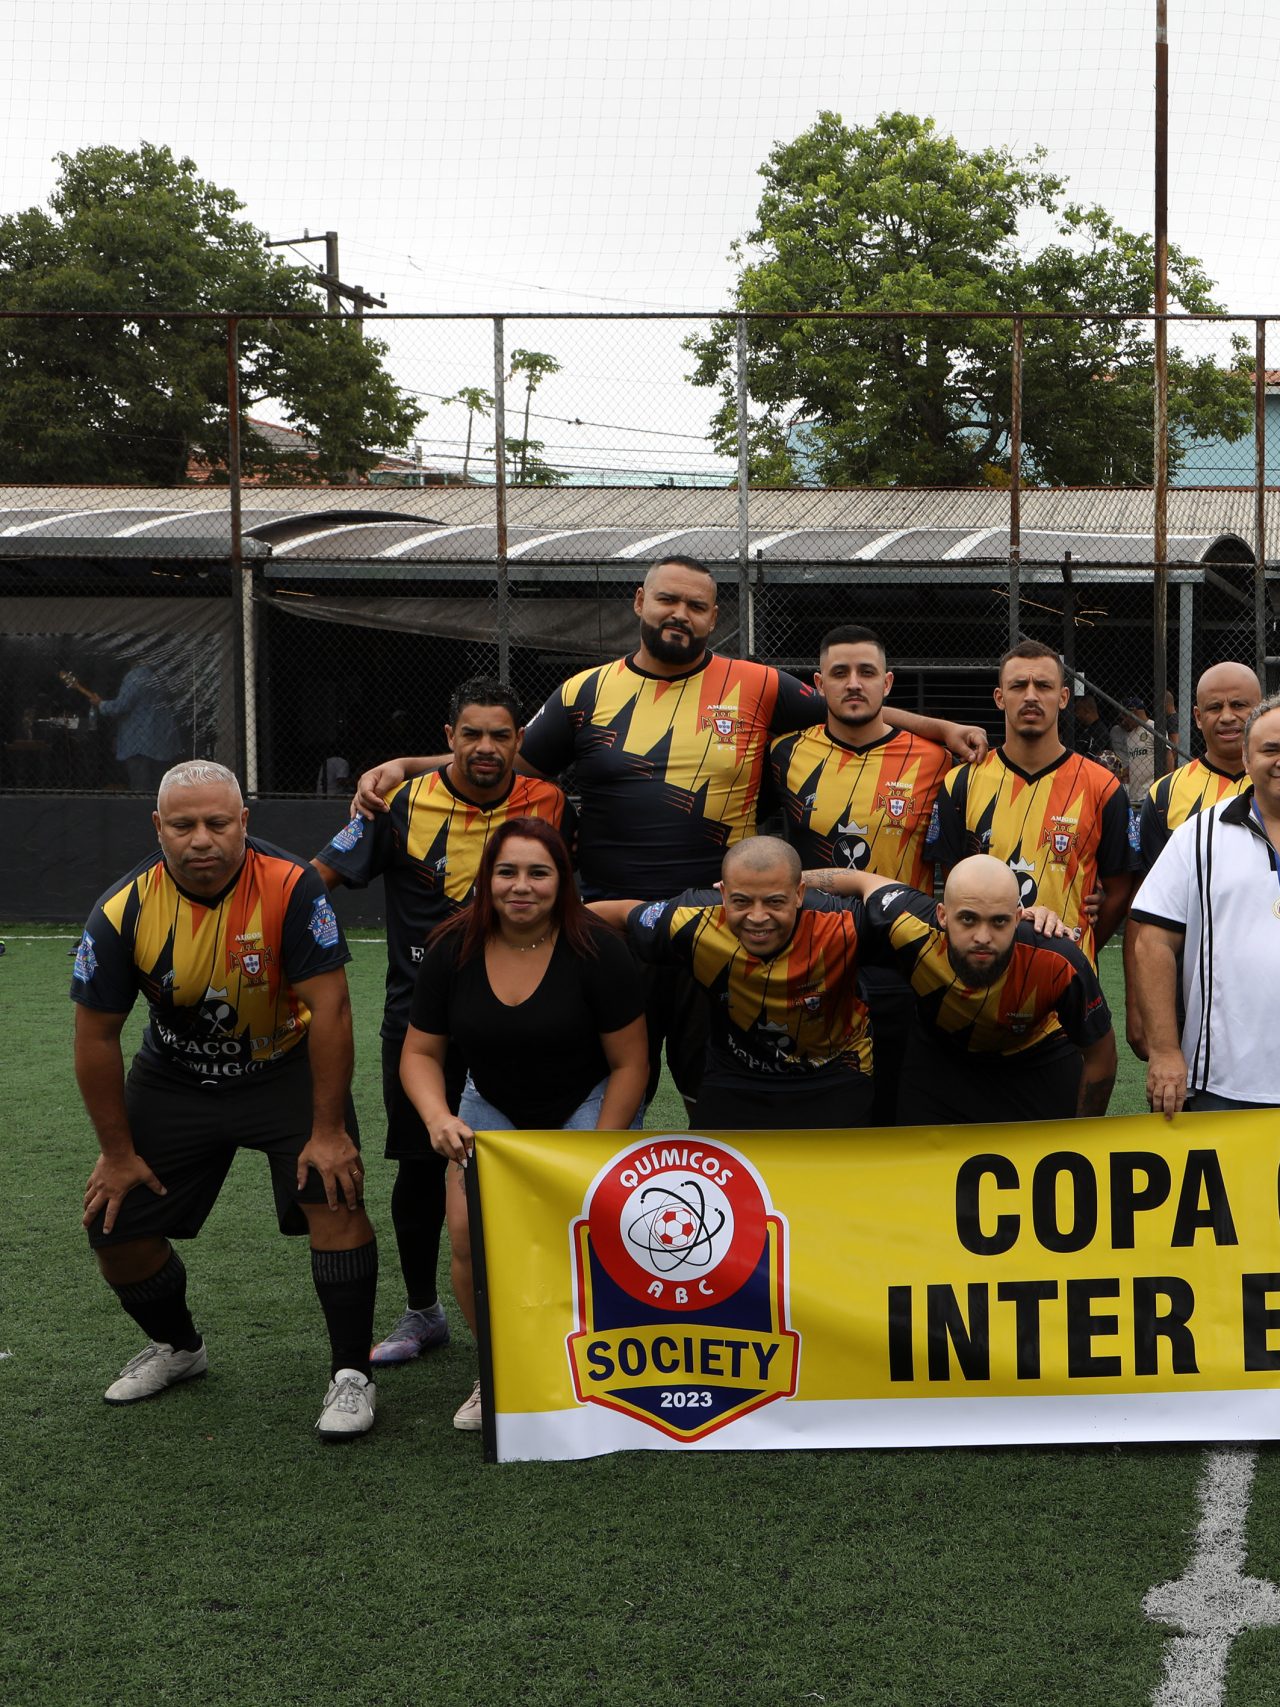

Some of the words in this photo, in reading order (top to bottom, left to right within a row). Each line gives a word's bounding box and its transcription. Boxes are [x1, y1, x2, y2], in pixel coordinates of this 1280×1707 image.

[885, 781, 912, 789] AMIGOS
[1050, 815, 1078, 824] AMIGOS
[619, 1147, 733, 1188] QUÍMICOS
[955, 1149, 1239, 1256] COPA
[888, 1276, 1201, 1383] INTER
[586, 1336, 780, 1382] SOCIETY
[661, 1391, 713, 1408] 2023
